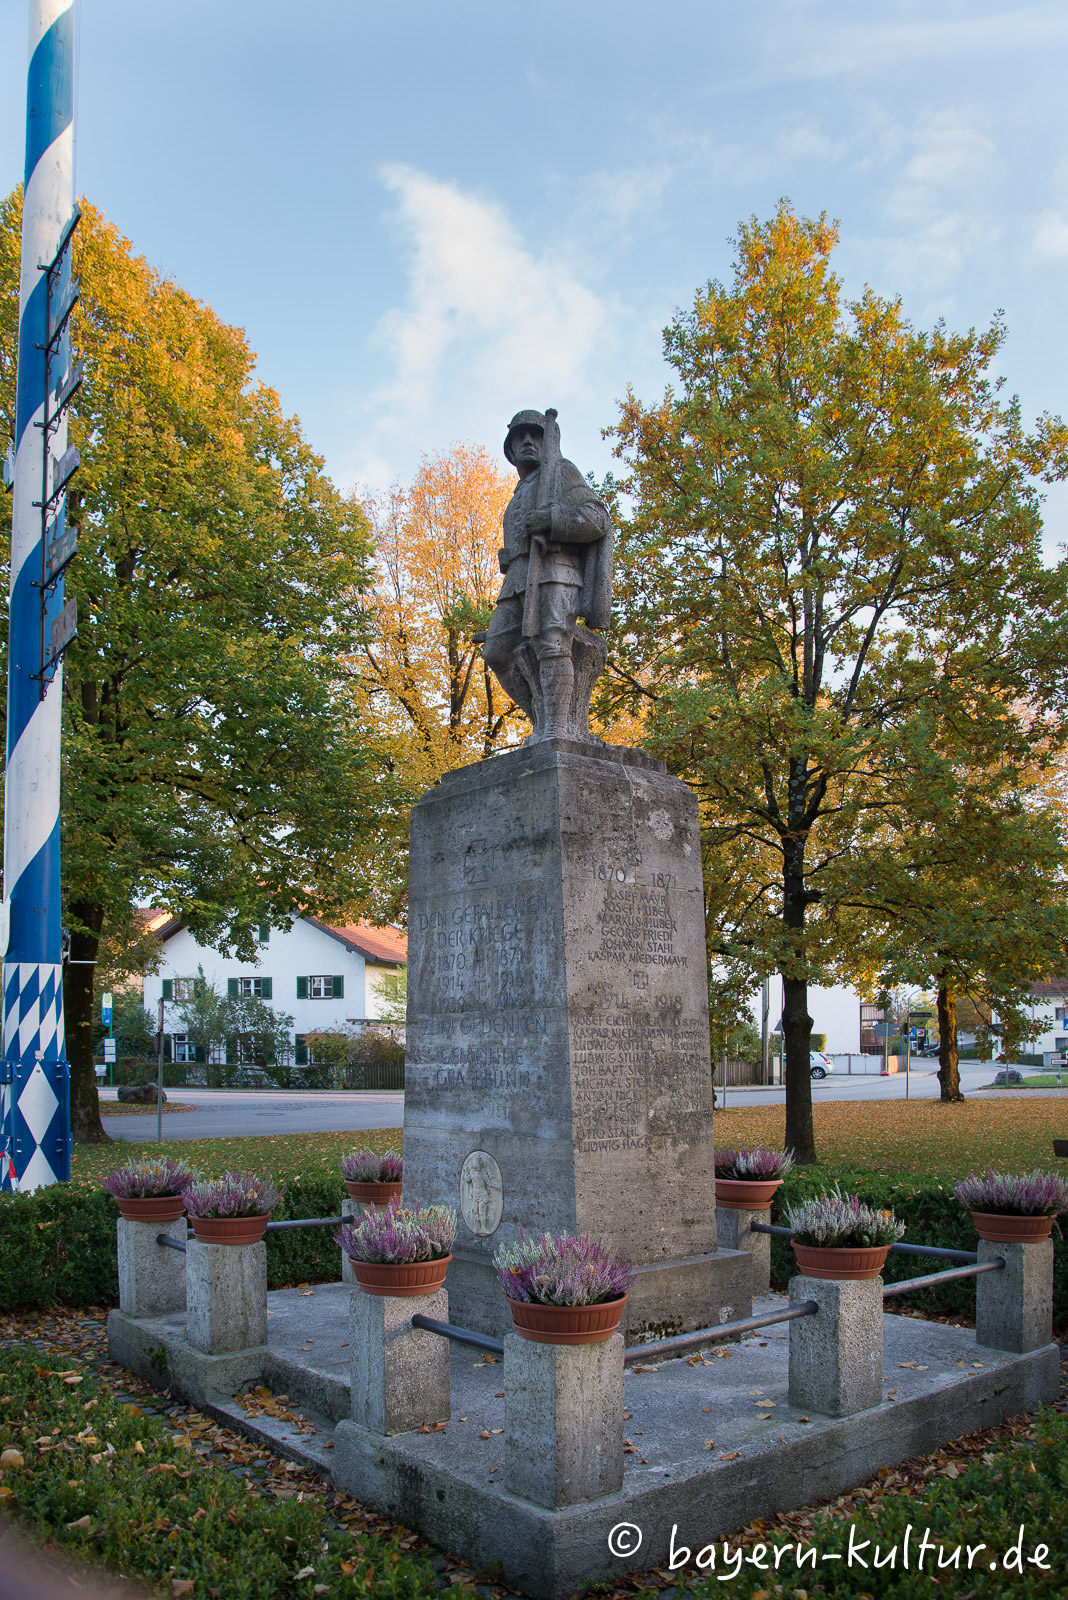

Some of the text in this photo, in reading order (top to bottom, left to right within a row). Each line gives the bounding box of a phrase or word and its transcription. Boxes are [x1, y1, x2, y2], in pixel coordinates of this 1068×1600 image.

[592, 863, 626, 883] 1870
[652, 872, 677, 889] 1871
[603, 889, 666, 906] JOSEF MAYR
[418, 893, 547, 931] DEN GEFALLENEN
[602, 901, 672, 919] JOSEF HUBER
[597, 912, 678, 933] MARKUS HUBER
[438, 922, 526, 950] DER KRIEGE
[601, 926, 640, 940] GEORG
[600, 938, 643, 953] JOHANN
[438, 952, 466, 971] 1870
[495, 947, 524, 966] 1871
[588, 950, 688, 968] KASPAR NIEDERMAYR
[438, 975, 465, 993] 1914
[655, 994, 683, 1010] 1918
[421, 1014, 547, 1036] ZUM GEDENKEN
[572, 1015, 606, 1027] JOSEF
[573, 1028, 612, 1039] KASPAR
[573, 1040, 616, 1051] LUDWIG
[438, 1046, 525, 1065] GEMEINDE
[573, 1053, 616, 1065] LUDWIG
[577, 1139, 619, 1153] LUDWIG
